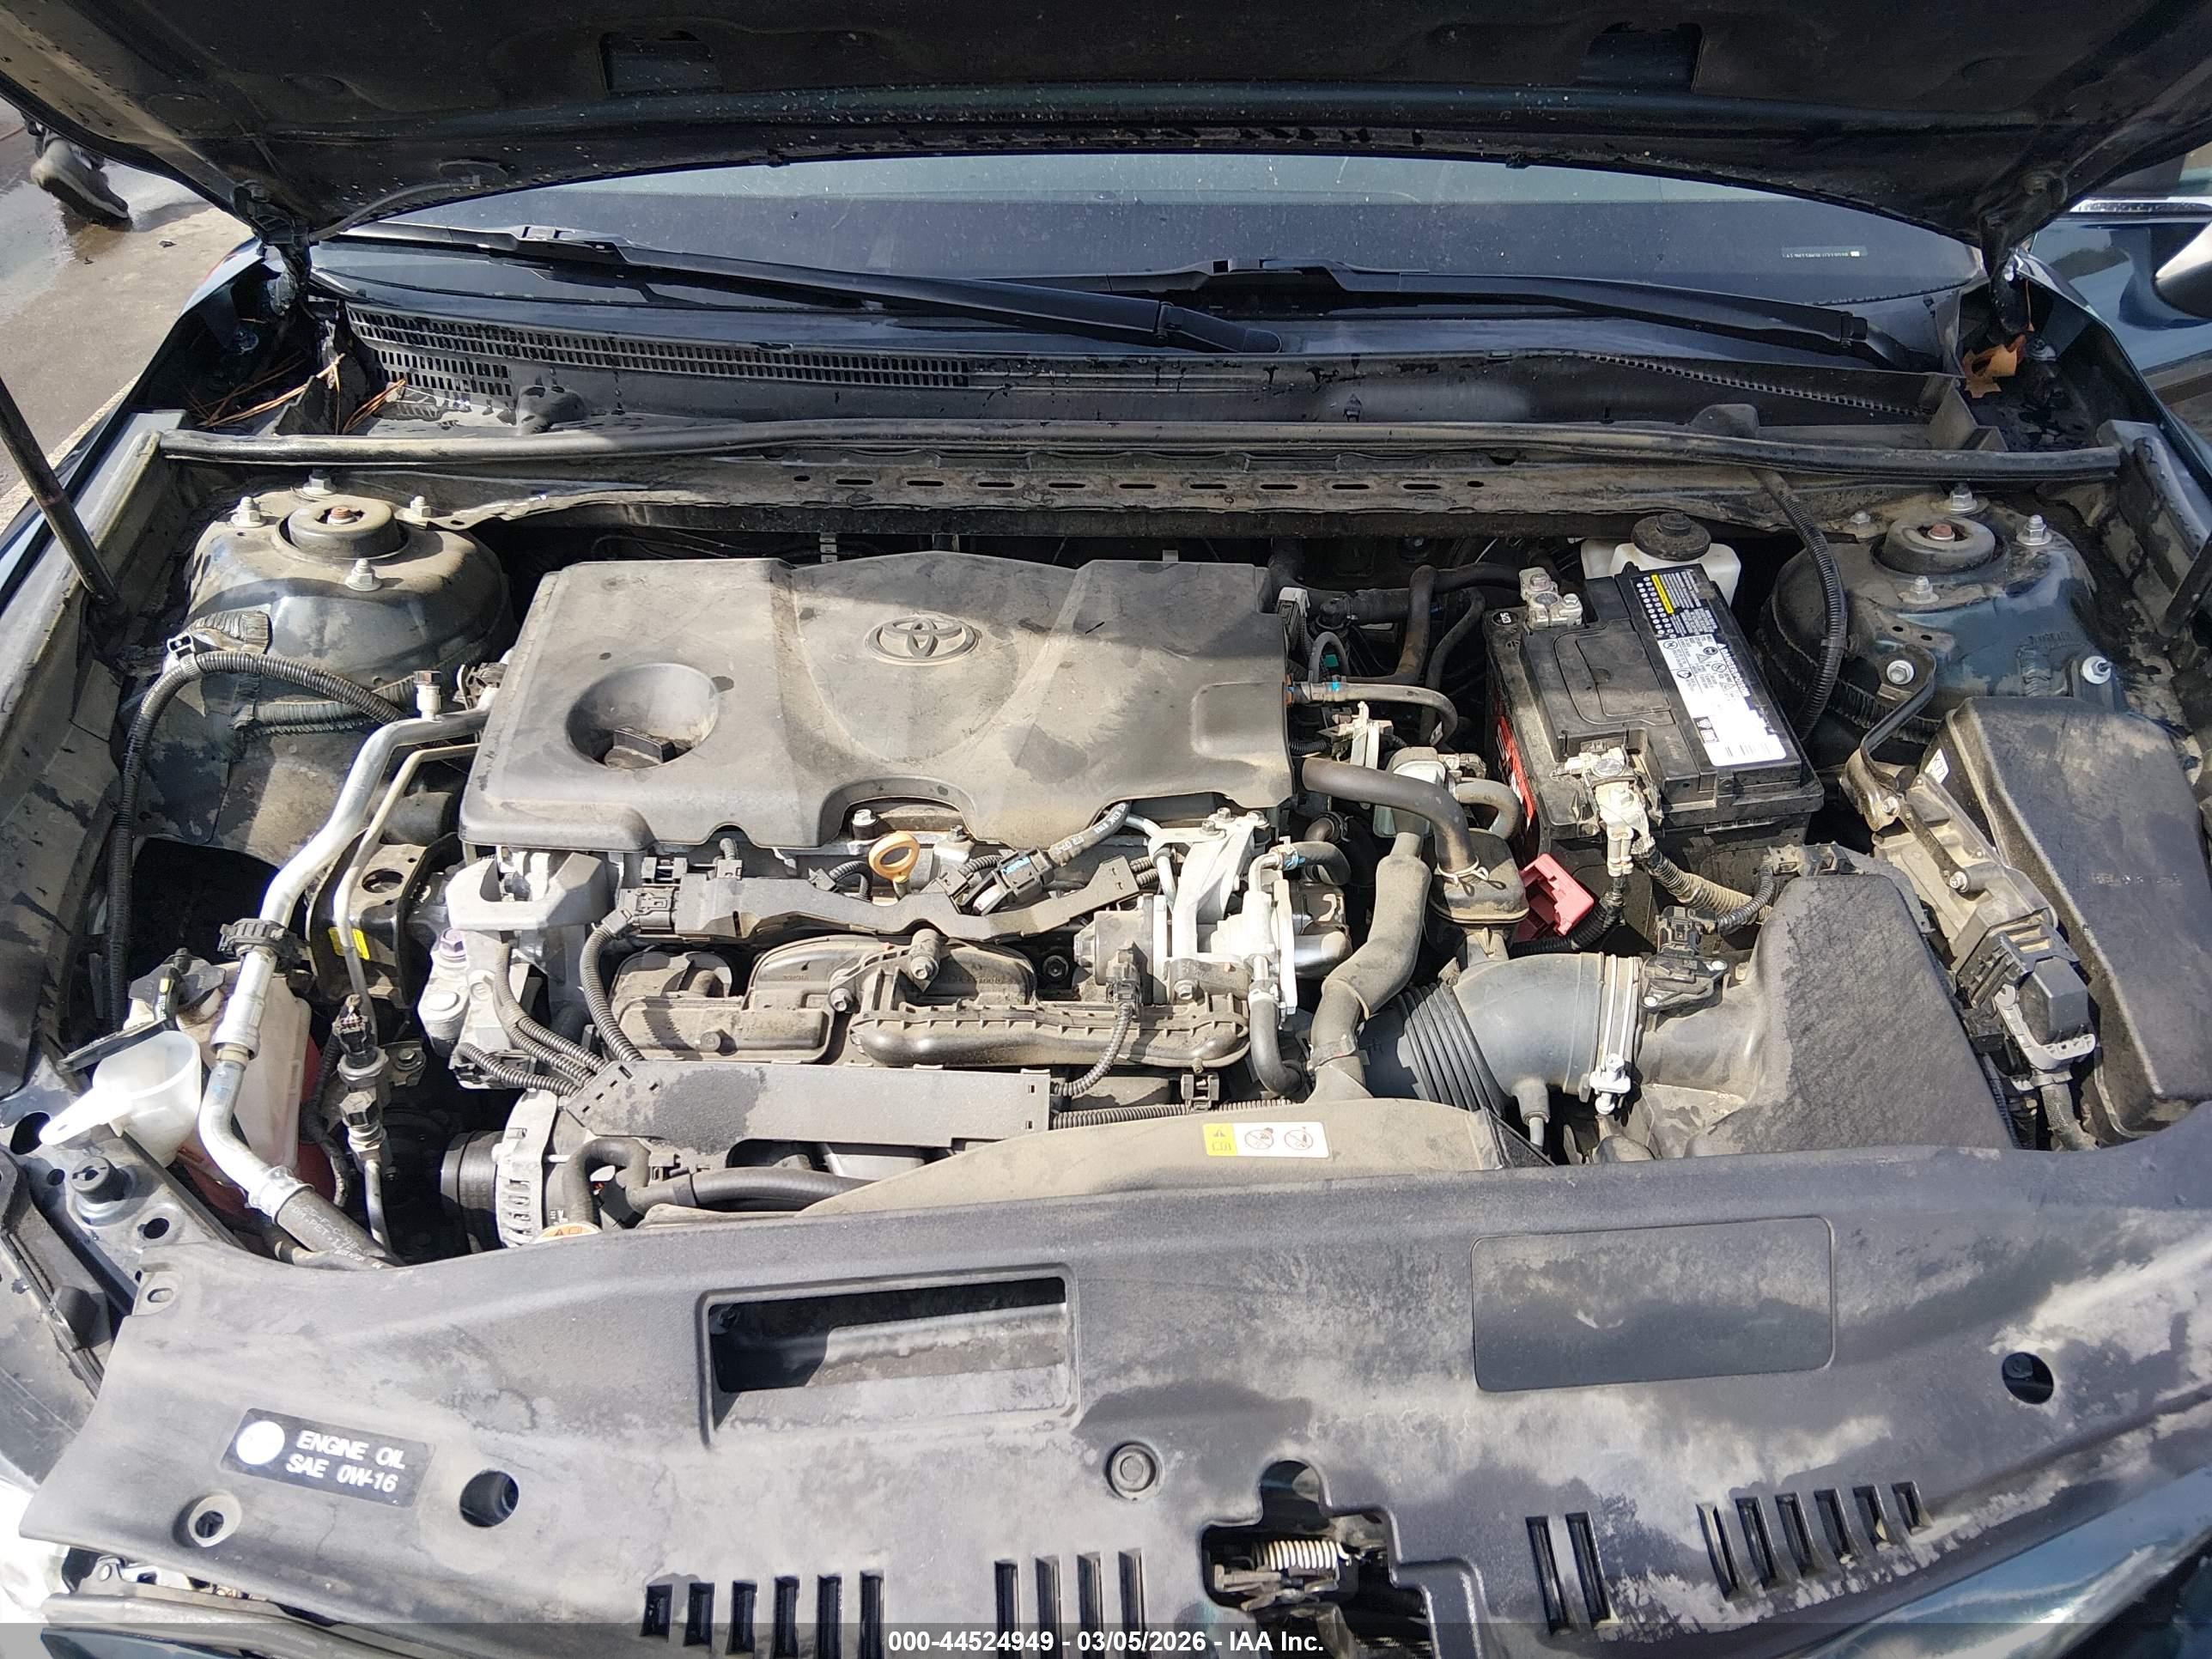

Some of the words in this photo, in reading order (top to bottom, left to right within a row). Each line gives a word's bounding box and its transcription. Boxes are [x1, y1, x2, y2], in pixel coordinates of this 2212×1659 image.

[295, 1430, 370, 1461] ENGINE
[375, 1446, 406, 1470] OIL
[285, 1453, 330, 1479] SAE
[337, 1464, 399, 1493] 0W-16
